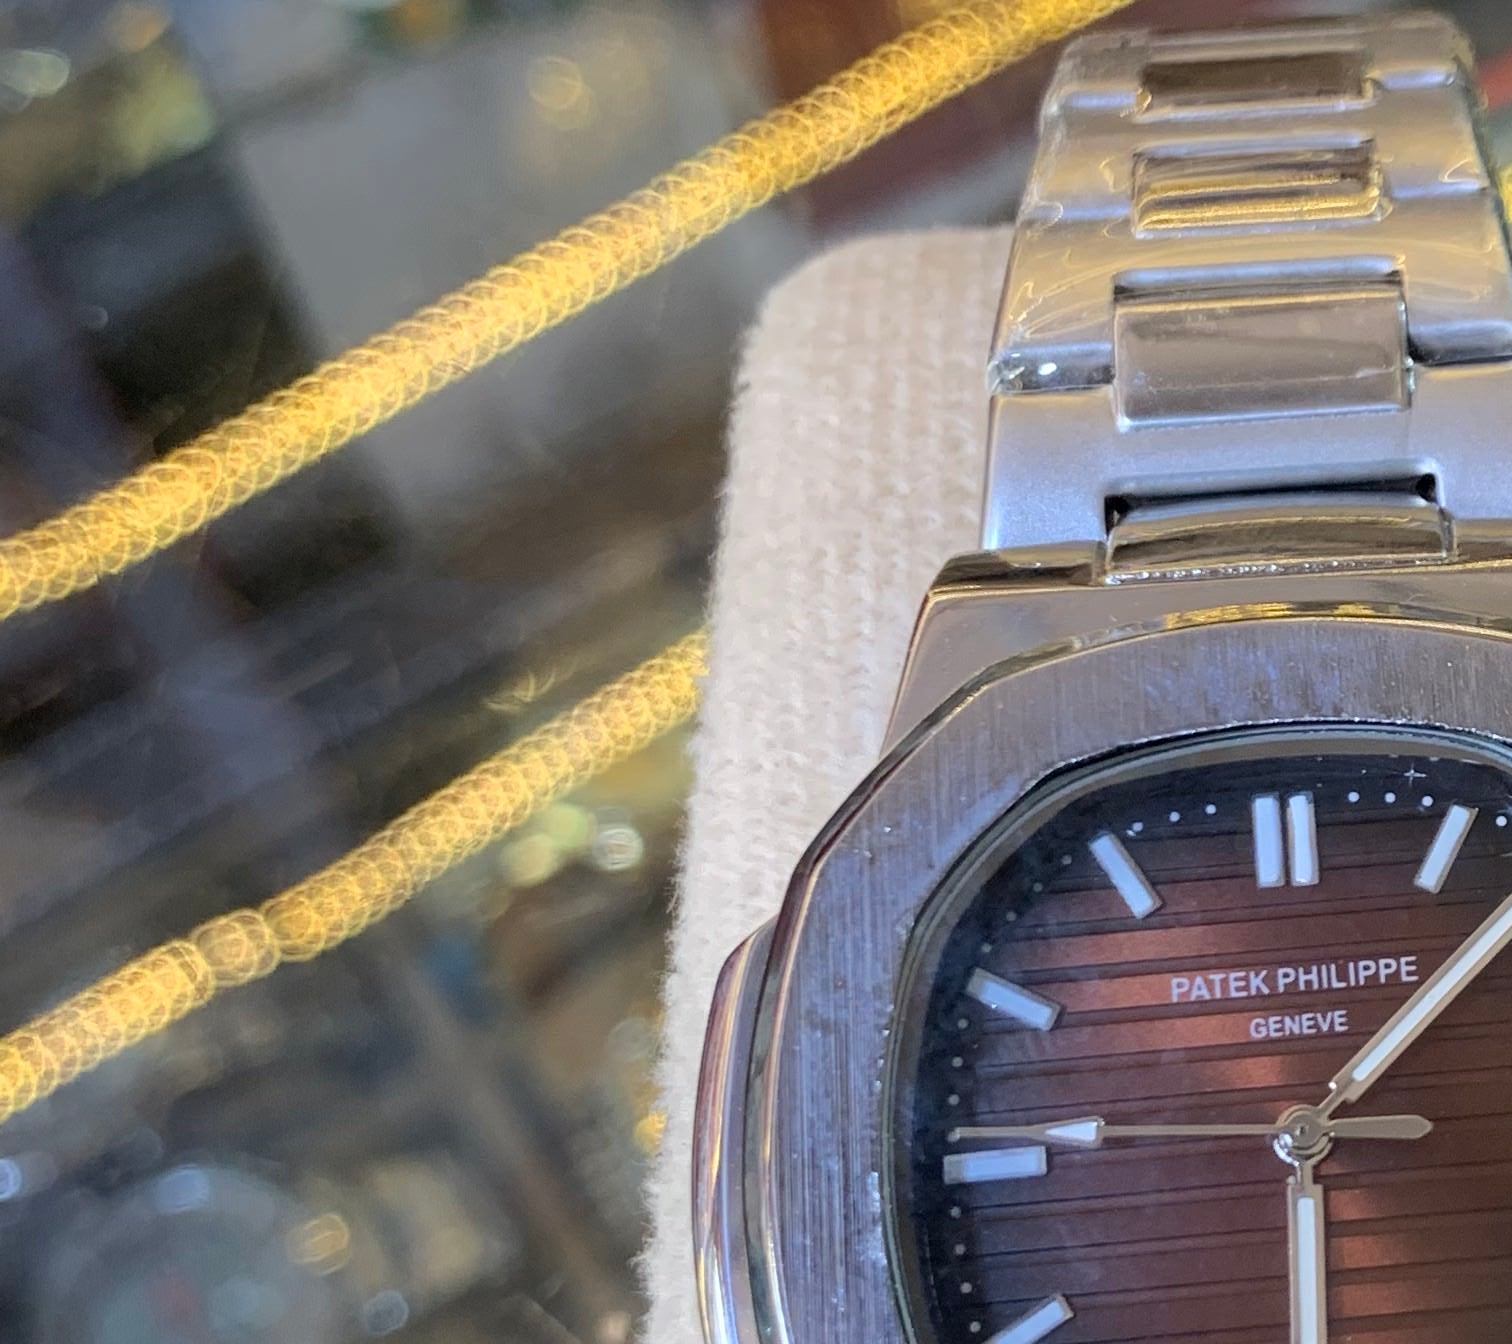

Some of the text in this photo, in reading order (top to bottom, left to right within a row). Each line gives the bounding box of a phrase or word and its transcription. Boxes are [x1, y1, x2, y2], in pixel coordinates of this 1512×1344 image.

[1170, 956, 1419, 1003] PATEK PHILIPPE
[1250, 1010, 1349, 1038] GENEVE
